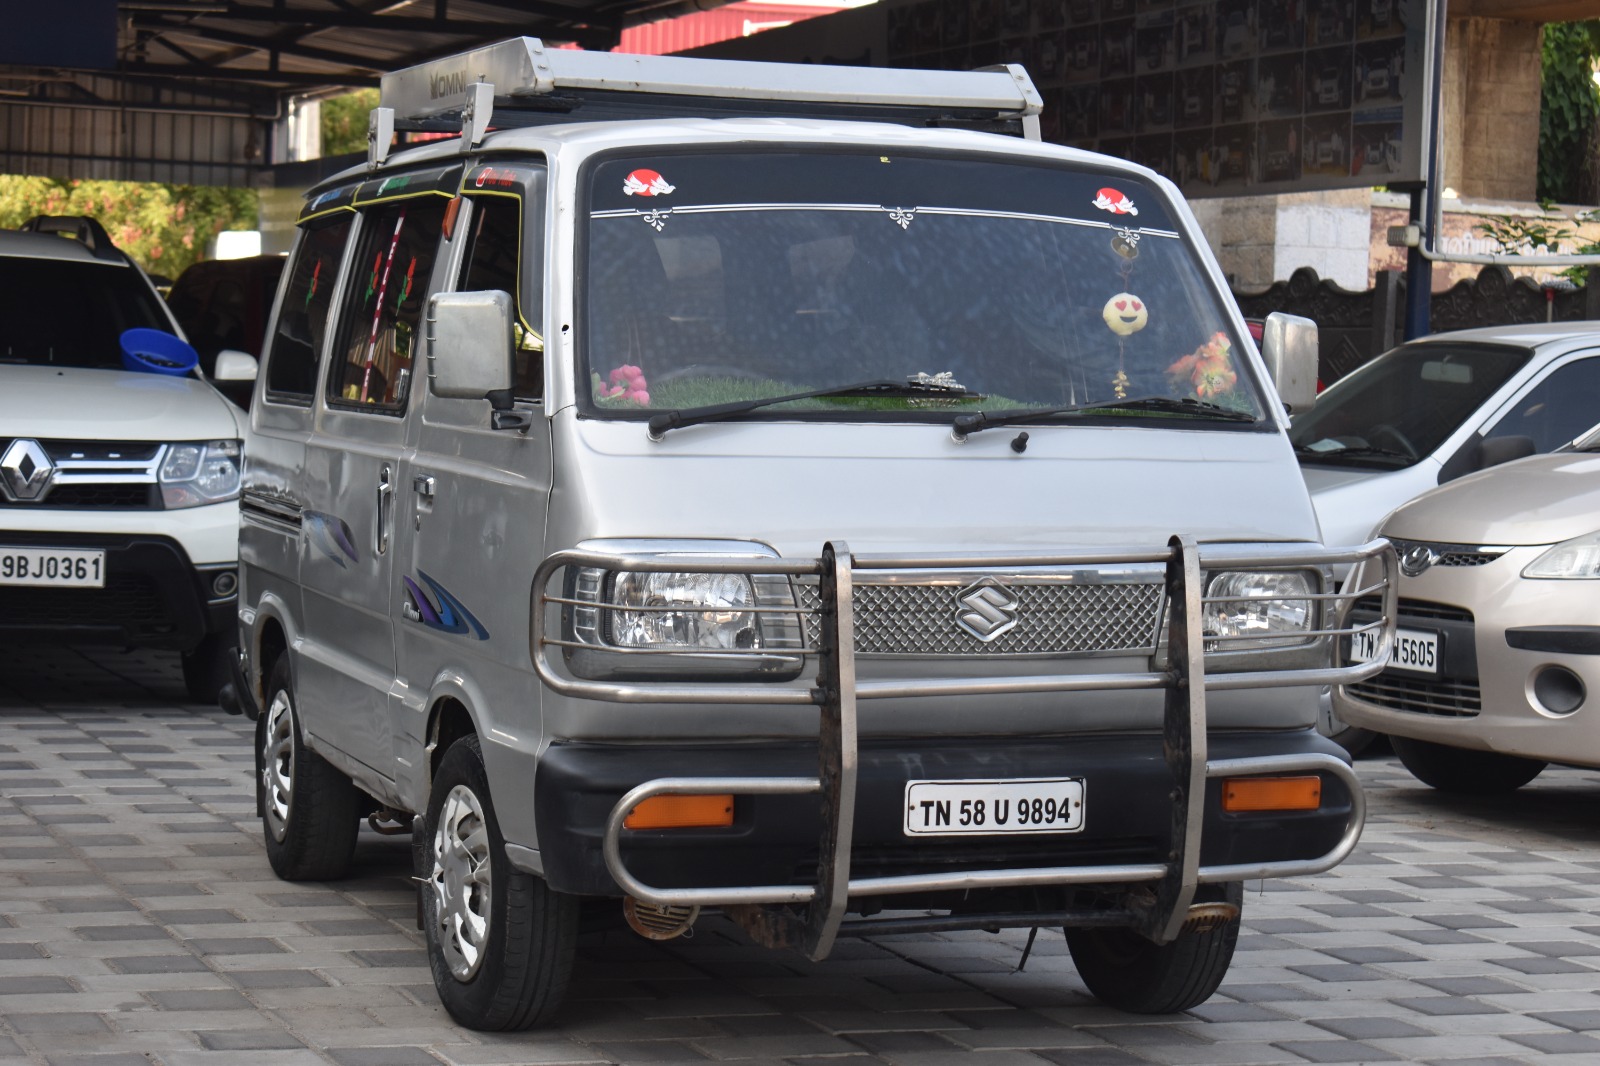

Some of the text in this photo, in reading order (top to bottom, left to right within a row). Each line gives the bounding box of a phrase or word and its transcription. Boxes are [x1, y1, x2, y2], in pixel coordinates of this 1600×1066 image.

[2, 555, 101, 581] 9BJ0361
[1359, 632, 1374, 659] TN
[920, 797, 1071, 827] TN 58 U 9894
